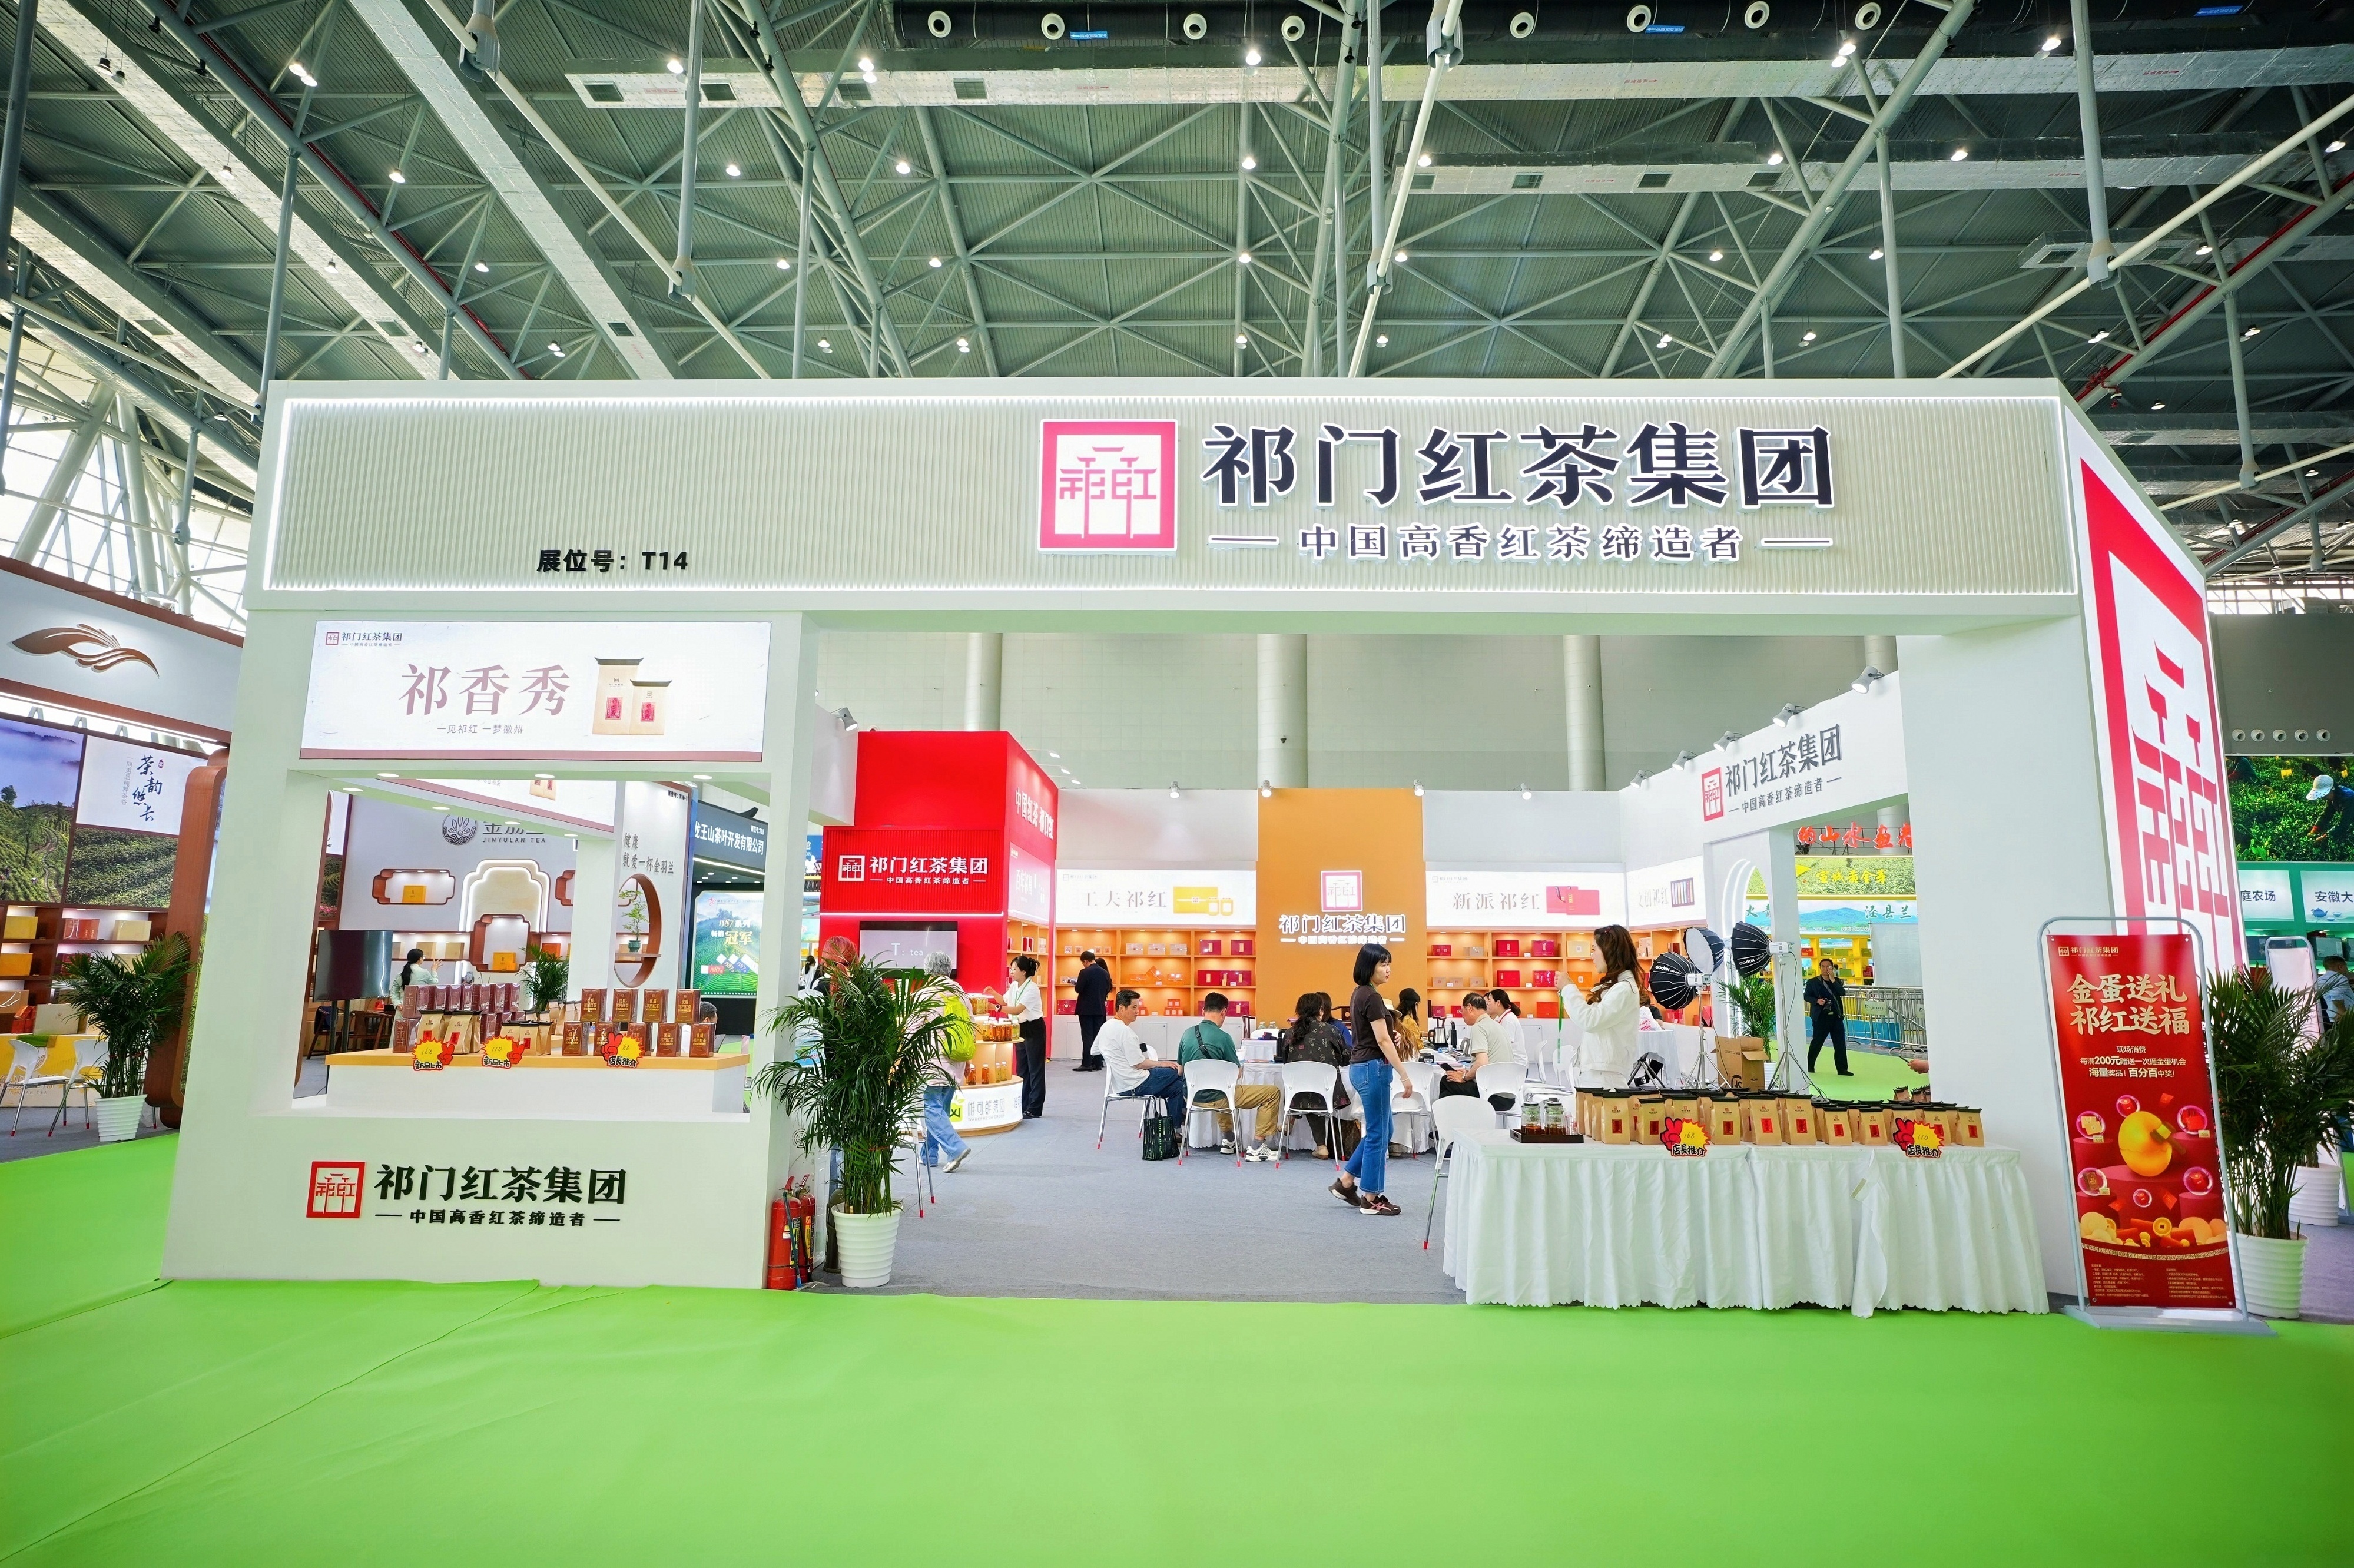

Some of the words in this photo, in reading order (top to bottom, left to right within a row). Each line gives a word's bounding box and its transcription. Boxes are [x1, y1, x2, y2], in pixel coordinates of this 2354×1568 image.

[1201, 422, 1832, 512] 祁门红茶集团
[1299, 523, 1743, 563] 中国高香红茶缔造者
[342, 632, 402, 641] 祁门红茶集团
[398, 664, 570, 715] 祁香秀
[437, 724, 478, 734] 一见祁红
[482, 724, 523, 734] 一梦徽州
[1725, 724, 1842, 797] 祁门红茶集团
[1742, 777, 1823, 813] 中国高香红茶缔造者
[1016, 787, 1038, 828] 中国红茶
[624, 832, 638, 850] 健康
[623, 852, 674, 874] 就爱一杯金羽兰
[869, 857, 987, 874] 祁门红茶集团
[1453, 891, 1540, 910] 新派祁红
[2315, 891, 2354, 903] 安徽大
[1865, 904, 1918, 919] 泾县兰
[1279, 913, 1406, 934] 祁门红茶集团
[2067, 973, 2188, 1003] 金蛋送礼
[2070, 1005, 2190, 1035] 祁红送福
[415, 1059, 442, 1069] 新品上市
[483, 1055, 510, 1066] 新品上市
[608, 1055, 636, 1067] 店長推介
[2080, 1056, 2186, 1066] 每满200元赠送一次砸金蛋机会
[1672, 1145, 1705, 1156] 店長推介
[1906, 1144, 1940, 1158] 店長推介
[374, 1164, 626, 1204] 祁门红茶集团
[410, 1209, 585, 1227] 中国高香红茶缔造者
